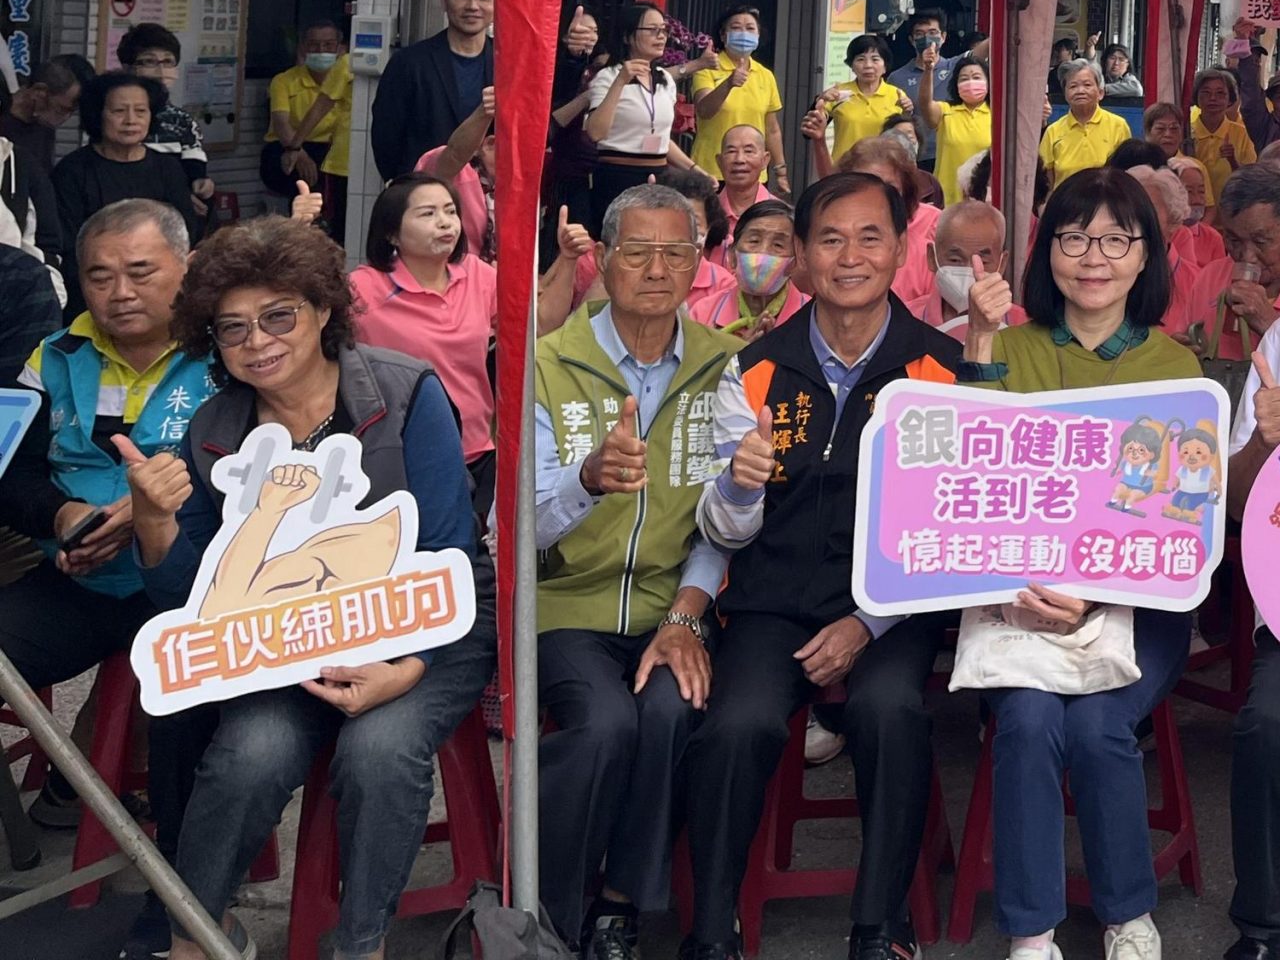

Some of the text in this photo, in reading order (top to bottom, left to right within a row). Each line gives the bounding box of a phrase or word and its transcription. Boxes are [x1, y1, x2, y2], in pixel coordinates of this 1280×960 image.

[156, 385, 193, 455] 朱信
[794, 391, 813, 443] 執行長
[899, 407, 1110, 468] 銀向健康
[936, 473, 1076, 521] 活到老
[897, 527, 1199, 576] 憶起運動 沒煩惱
[161, 575, 450, 685] 作伙練肌力
